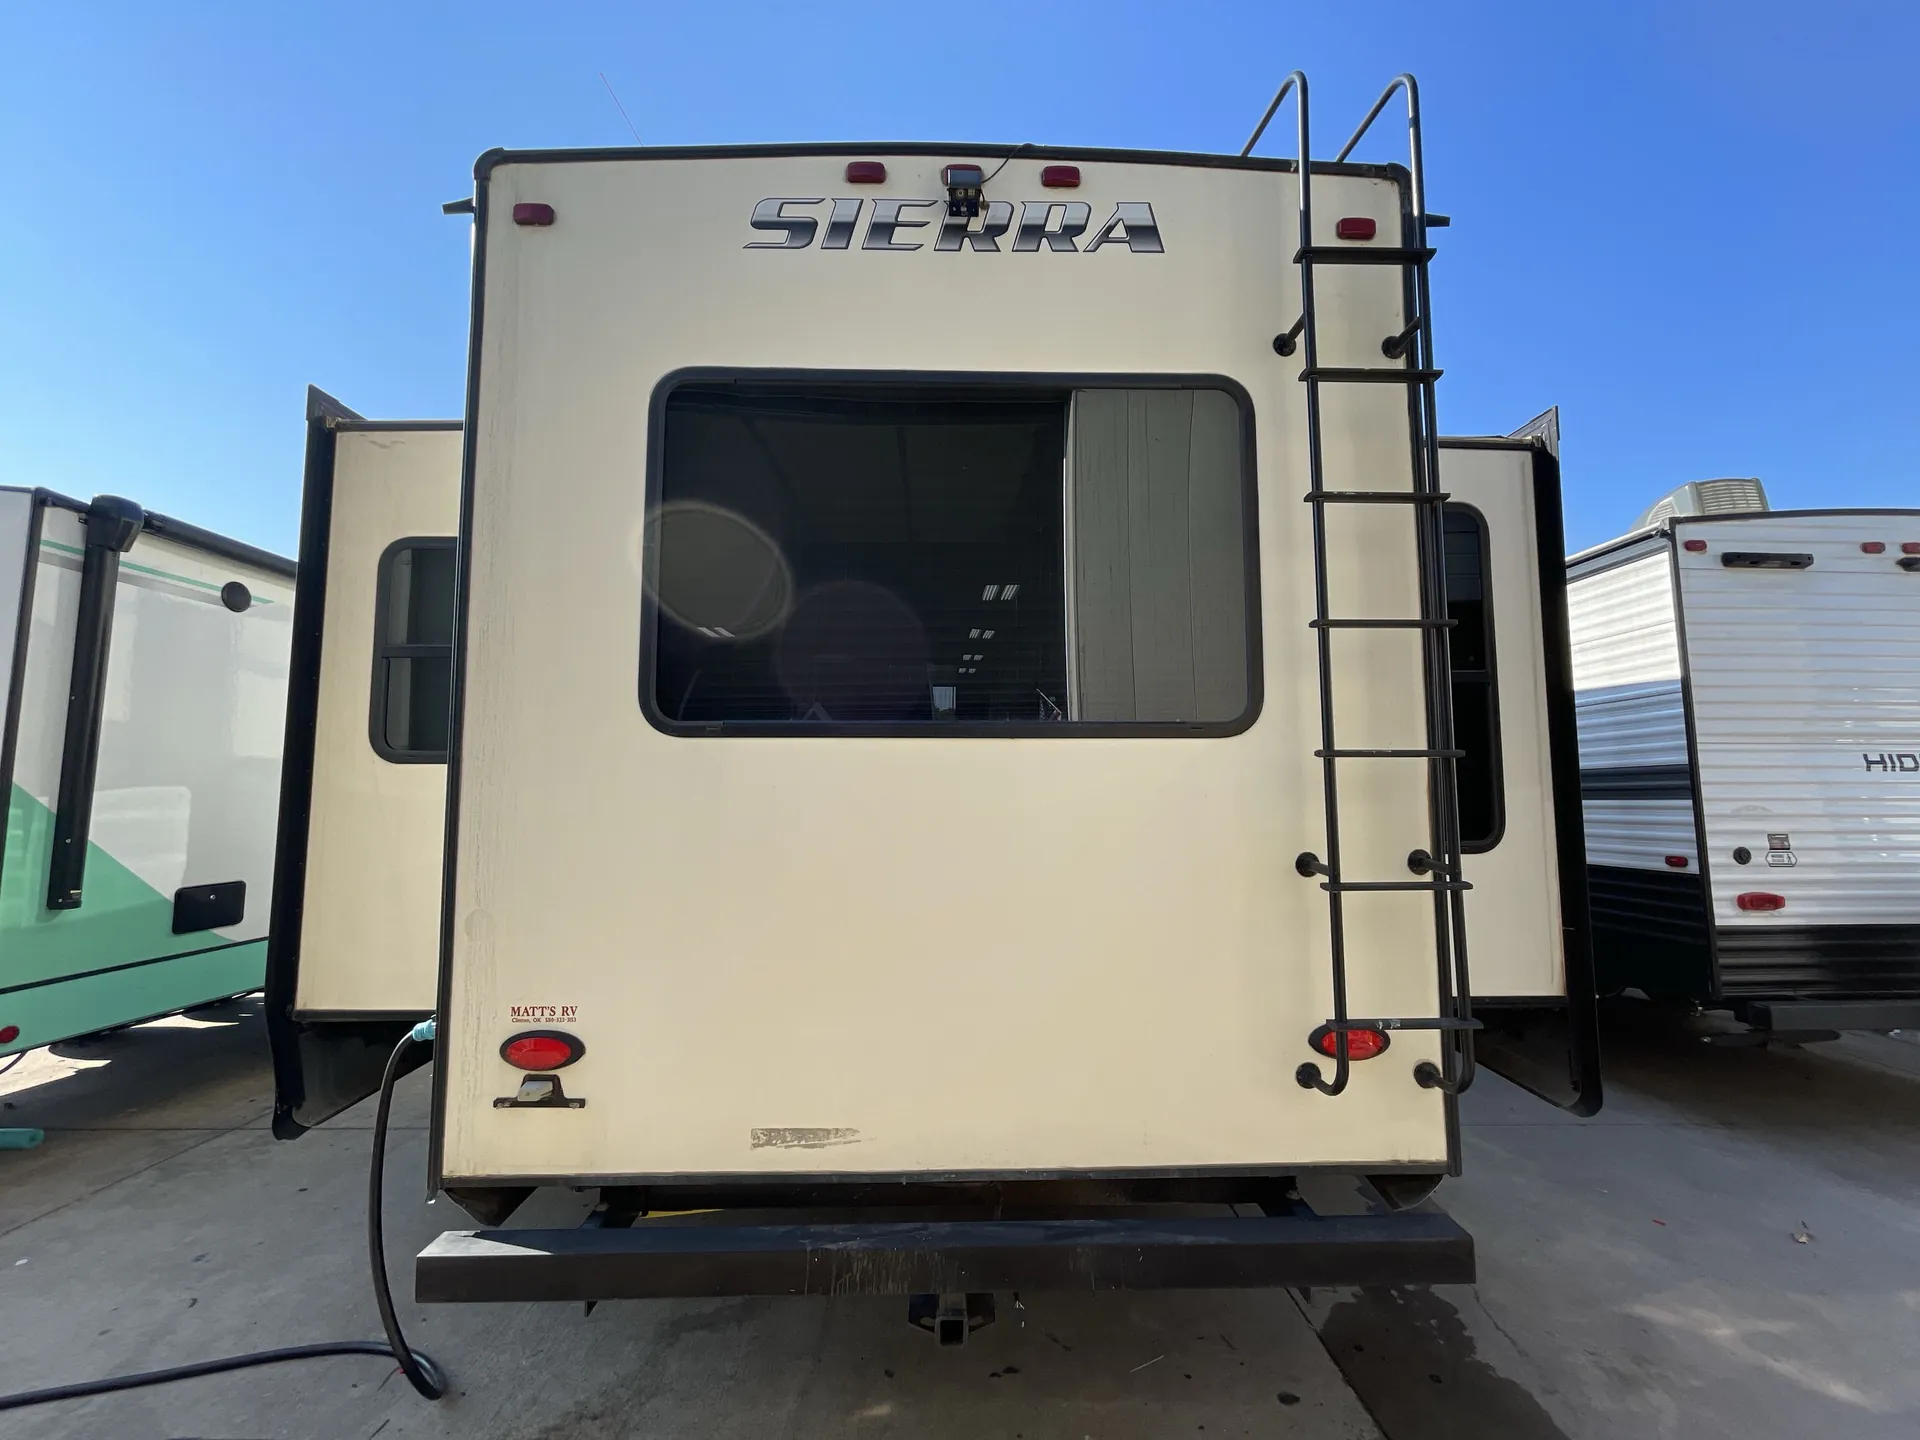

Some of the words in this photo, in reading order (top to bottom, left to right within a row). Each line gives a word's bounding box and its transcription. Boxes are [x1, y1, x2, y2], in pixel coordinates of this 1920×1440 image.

[743, 197, 1166, 254] SIERRA
[1862, 753, 1920, 772] HID
[510, 1005, 556, 1017] MATT'S
[561, 1005, 578, 1017] RV
